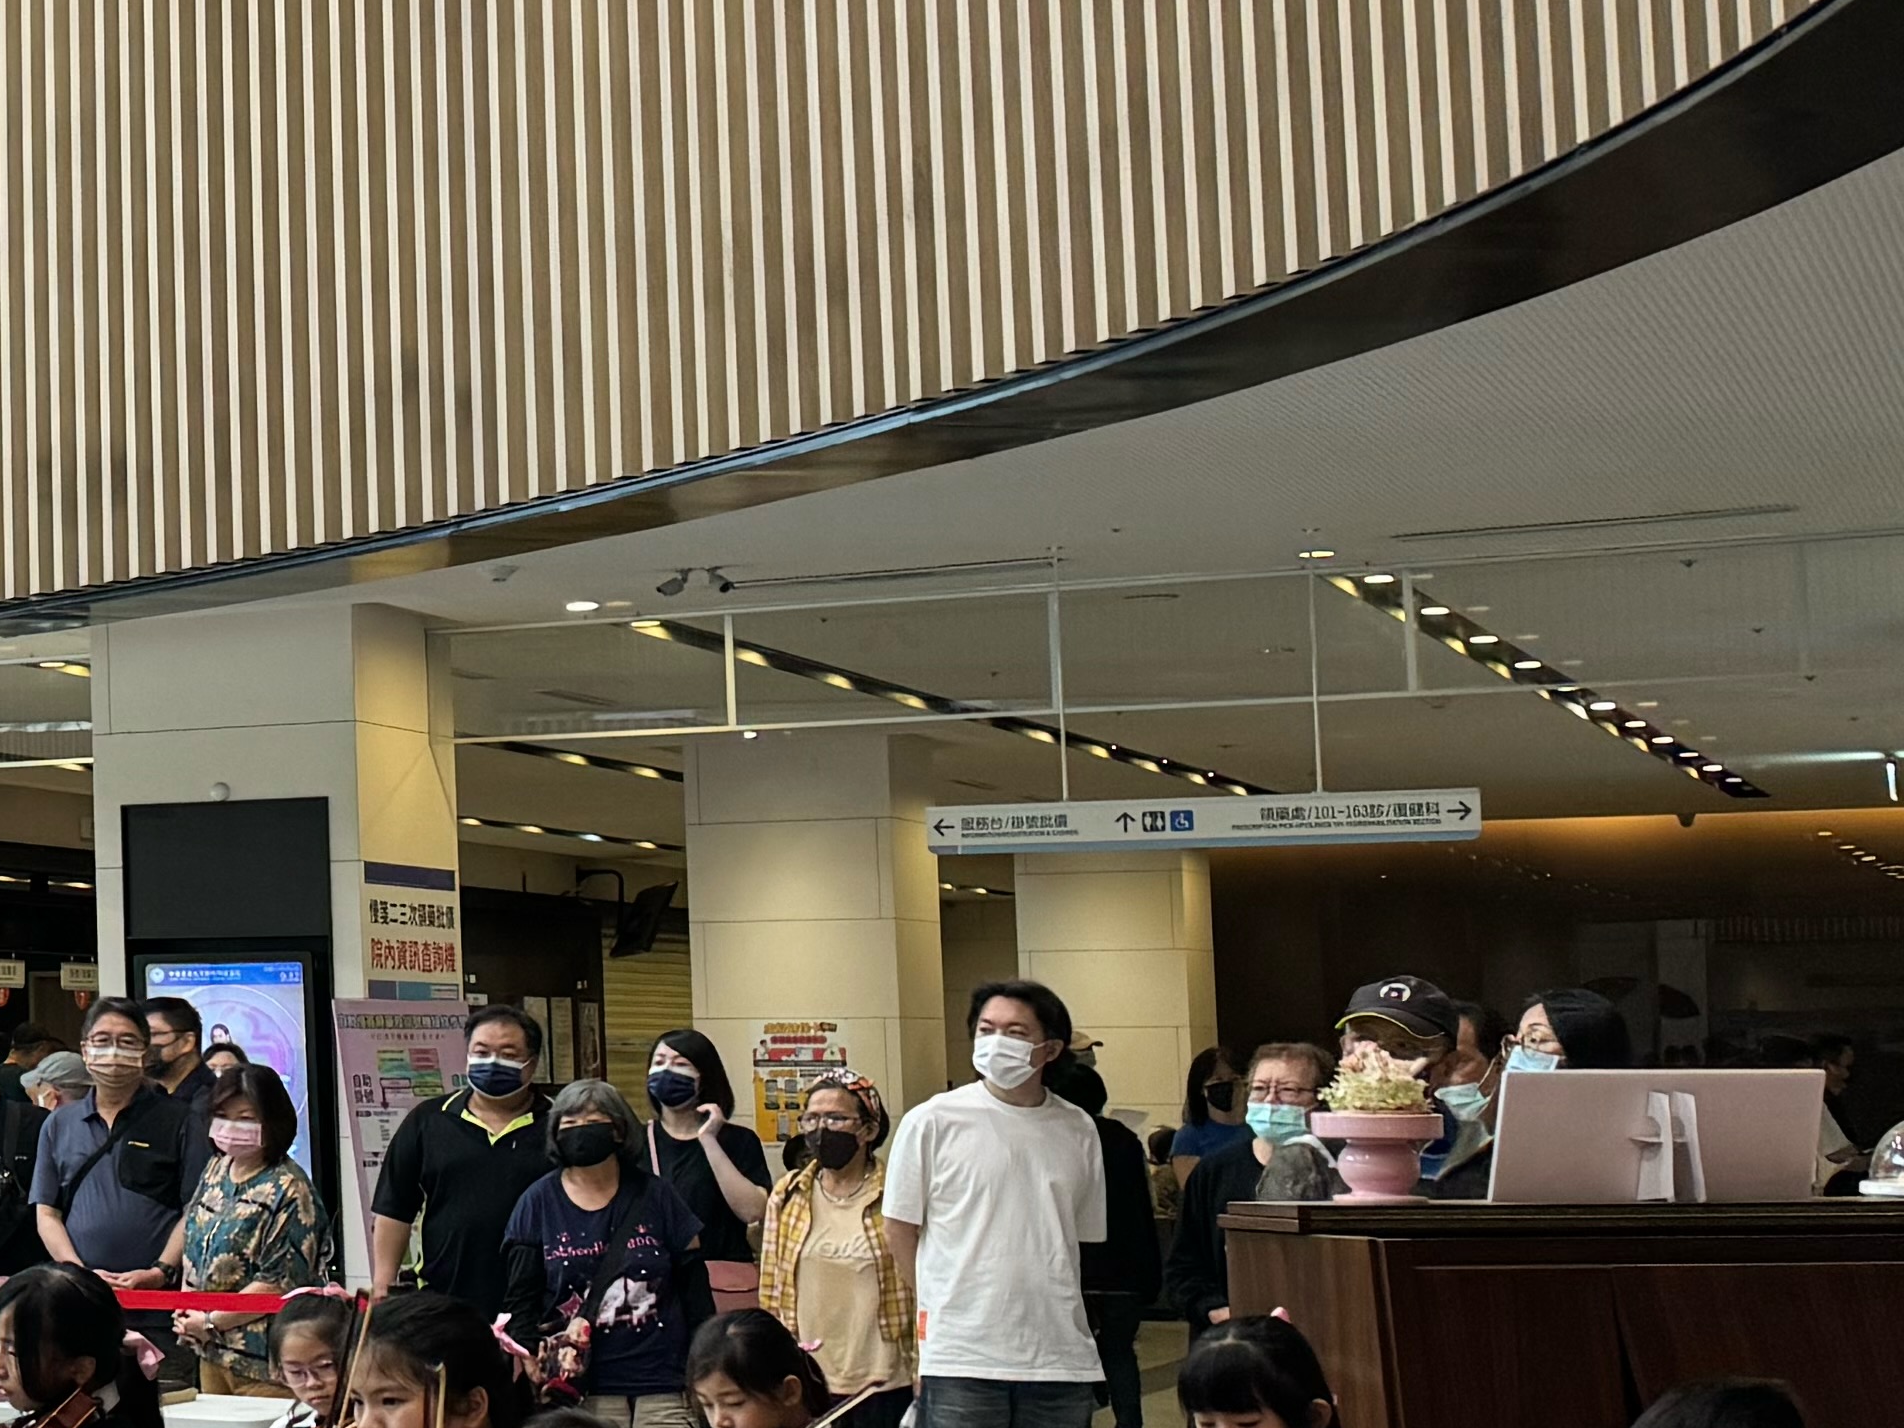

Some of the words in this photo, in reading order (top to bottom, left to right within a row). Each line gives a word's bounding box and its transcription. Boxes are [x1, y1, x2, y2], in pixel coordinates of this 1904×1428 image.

[370, 938, 457, 973] 院內資訊查詢機
